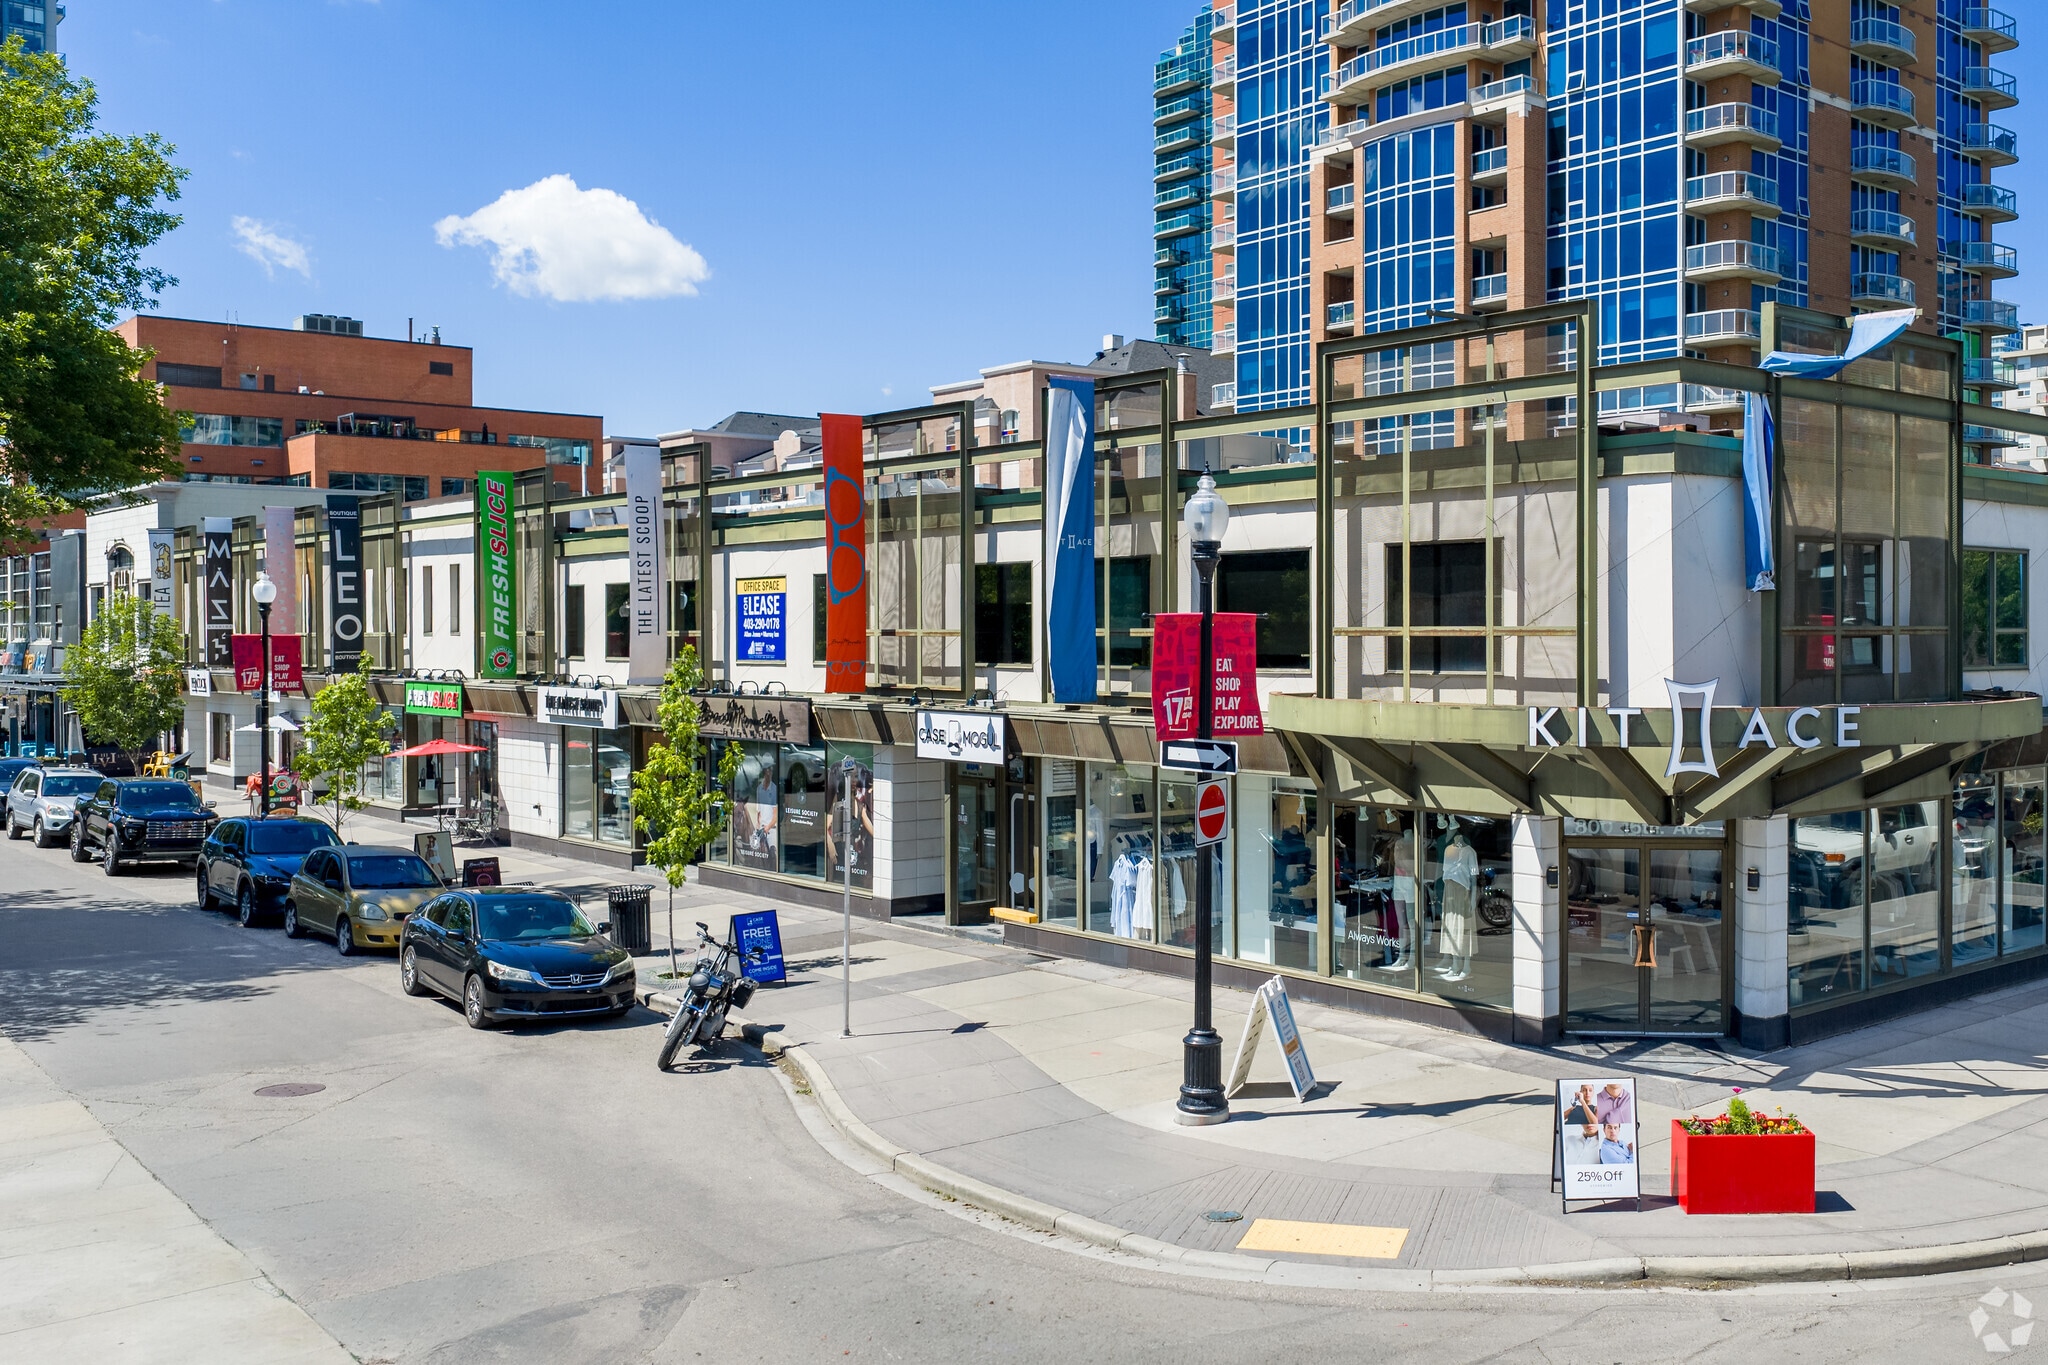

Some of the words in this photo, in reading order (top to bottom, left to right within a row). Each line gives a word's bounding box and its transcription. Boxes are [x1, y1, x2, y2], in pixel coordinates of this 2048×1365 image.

[634, 495, 650, 544] SCOOP
[1077, 538, 1093, 546] ACE
[486, 477, 510, 641] FRESHSLICE
[636, 551, 652, 603] LATEST
[334, 529, 363, 641] LEO
[743, 581, 761, 592] OFFICE
[761, 580, 780, 591] SPACE
[153, 587, 171, 610] TEA
[748, 595, 780, 616] LEASE
[637, 609, 652, 636] THE
[1215, 658, 1232, 671] EAT
[241, 671, 253, 685] 17
[1215, 677, 1240, 691] SHOP
[1215, 697, 1241, 710] PLAY
[1162, 697, 1183, 726] 17
[1214, 715, 1259, 729] EXPLORE
[1528, 706, 1642, 749] KIT
[1737, 706, 1862, 750] ACE
[919, 728, 945, 743] CASE
[963, 730, 1001, 748] MOGUL
[785, 807, 801, 815] LEISURE
[801, 809, 818, 818] SOCIETY
[1575, 819, 1613, 835] 800
[1672, 824, 1711, 836] Ave.
[754, 851, 769, 859] SOCIETY
[851, 867, 868, 876] SOCIETY
[743, 926, 772, 940] FREE
[1348, 930, 1375, 945] Always
[1376, 934, 1401, 949] Works
[744, 936, 773, 948] PHONE
[748, 966, 762, 974] COME
[1577, 1171, 1603, 1182] 25%
[1603, 1170, 1623, 1181] Off
